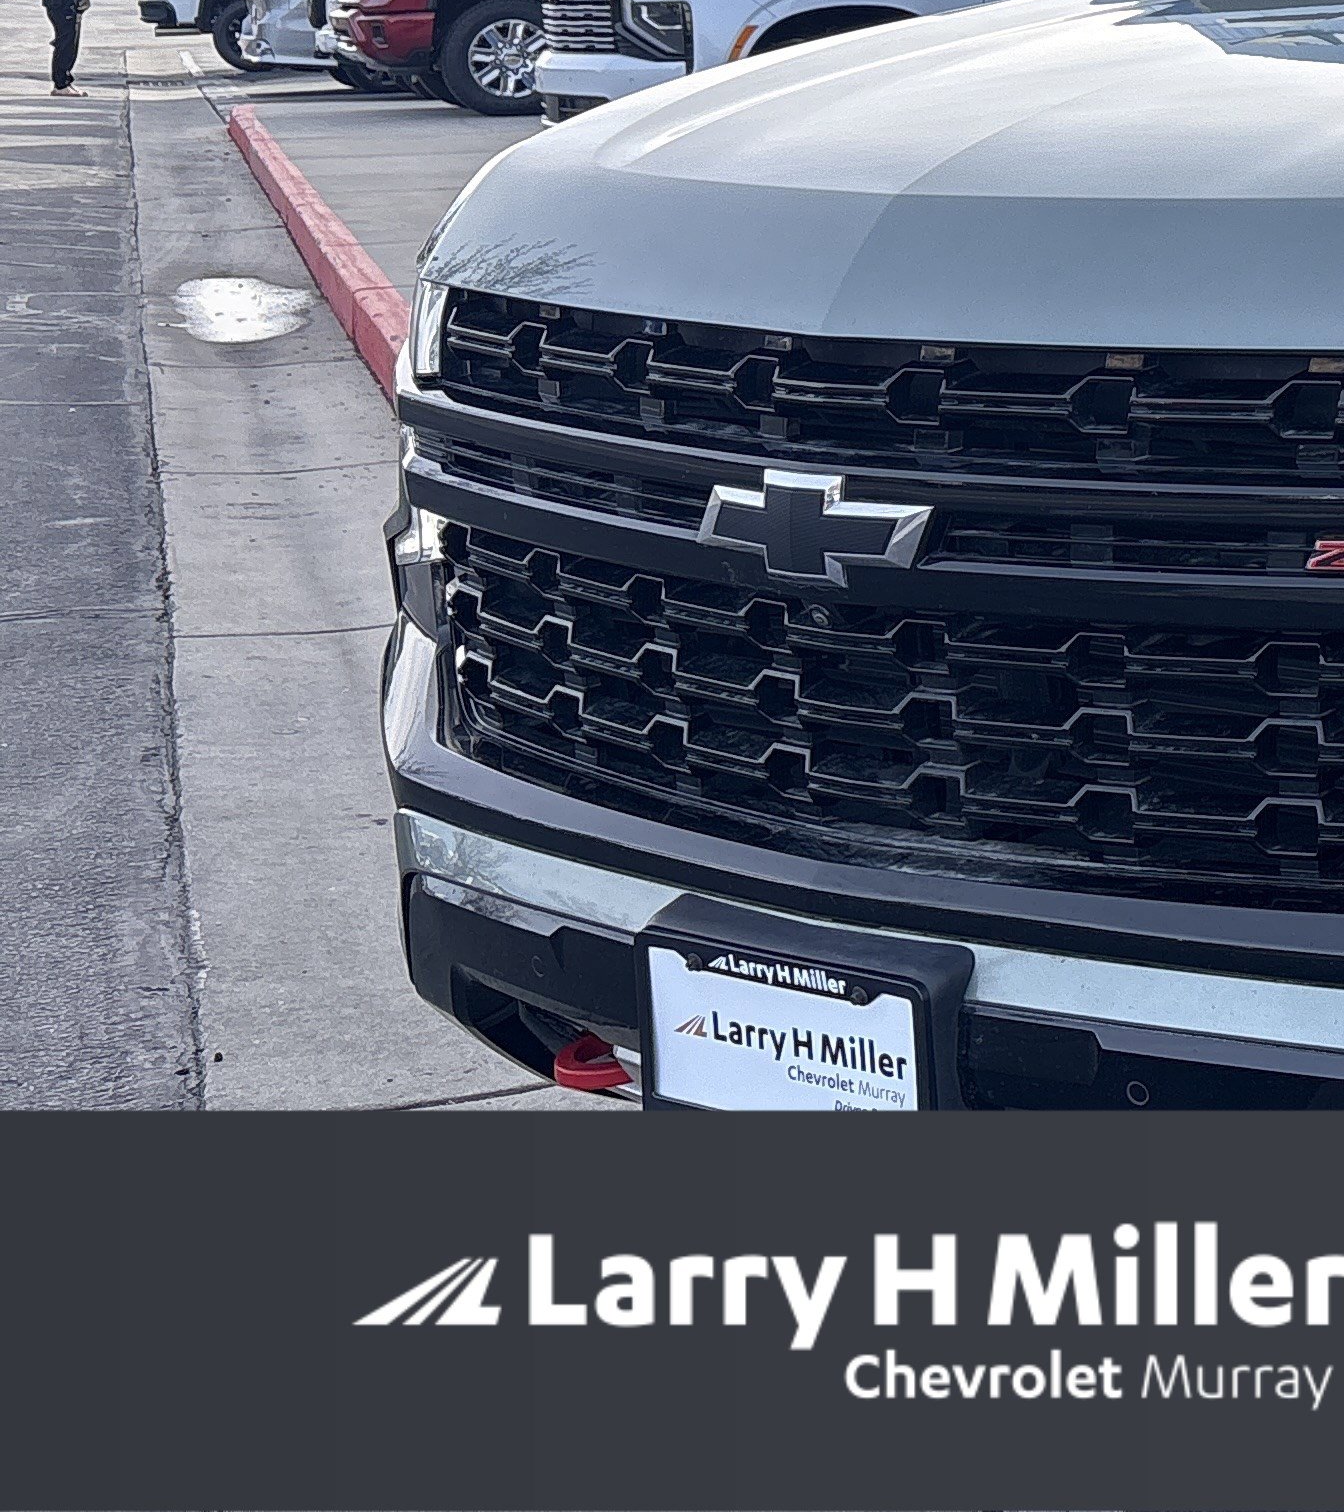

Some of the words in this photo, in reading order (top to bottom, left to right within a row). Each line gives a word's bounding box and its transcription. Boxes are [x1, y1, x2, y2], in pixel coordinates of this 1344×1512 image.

[729, 953, 775, 985] Larry
[776, 963, 790, 985] H
[792, 968, 847, 995] Miller
[712, 1010, 787, 1061] Larry
[792, 1026, 814, 1061] H
[820, 1033, 908, 1080] Miller
[787, 1065, 855, 1094] Chevrolet
[857, 1079, 906, 1109] Murray
